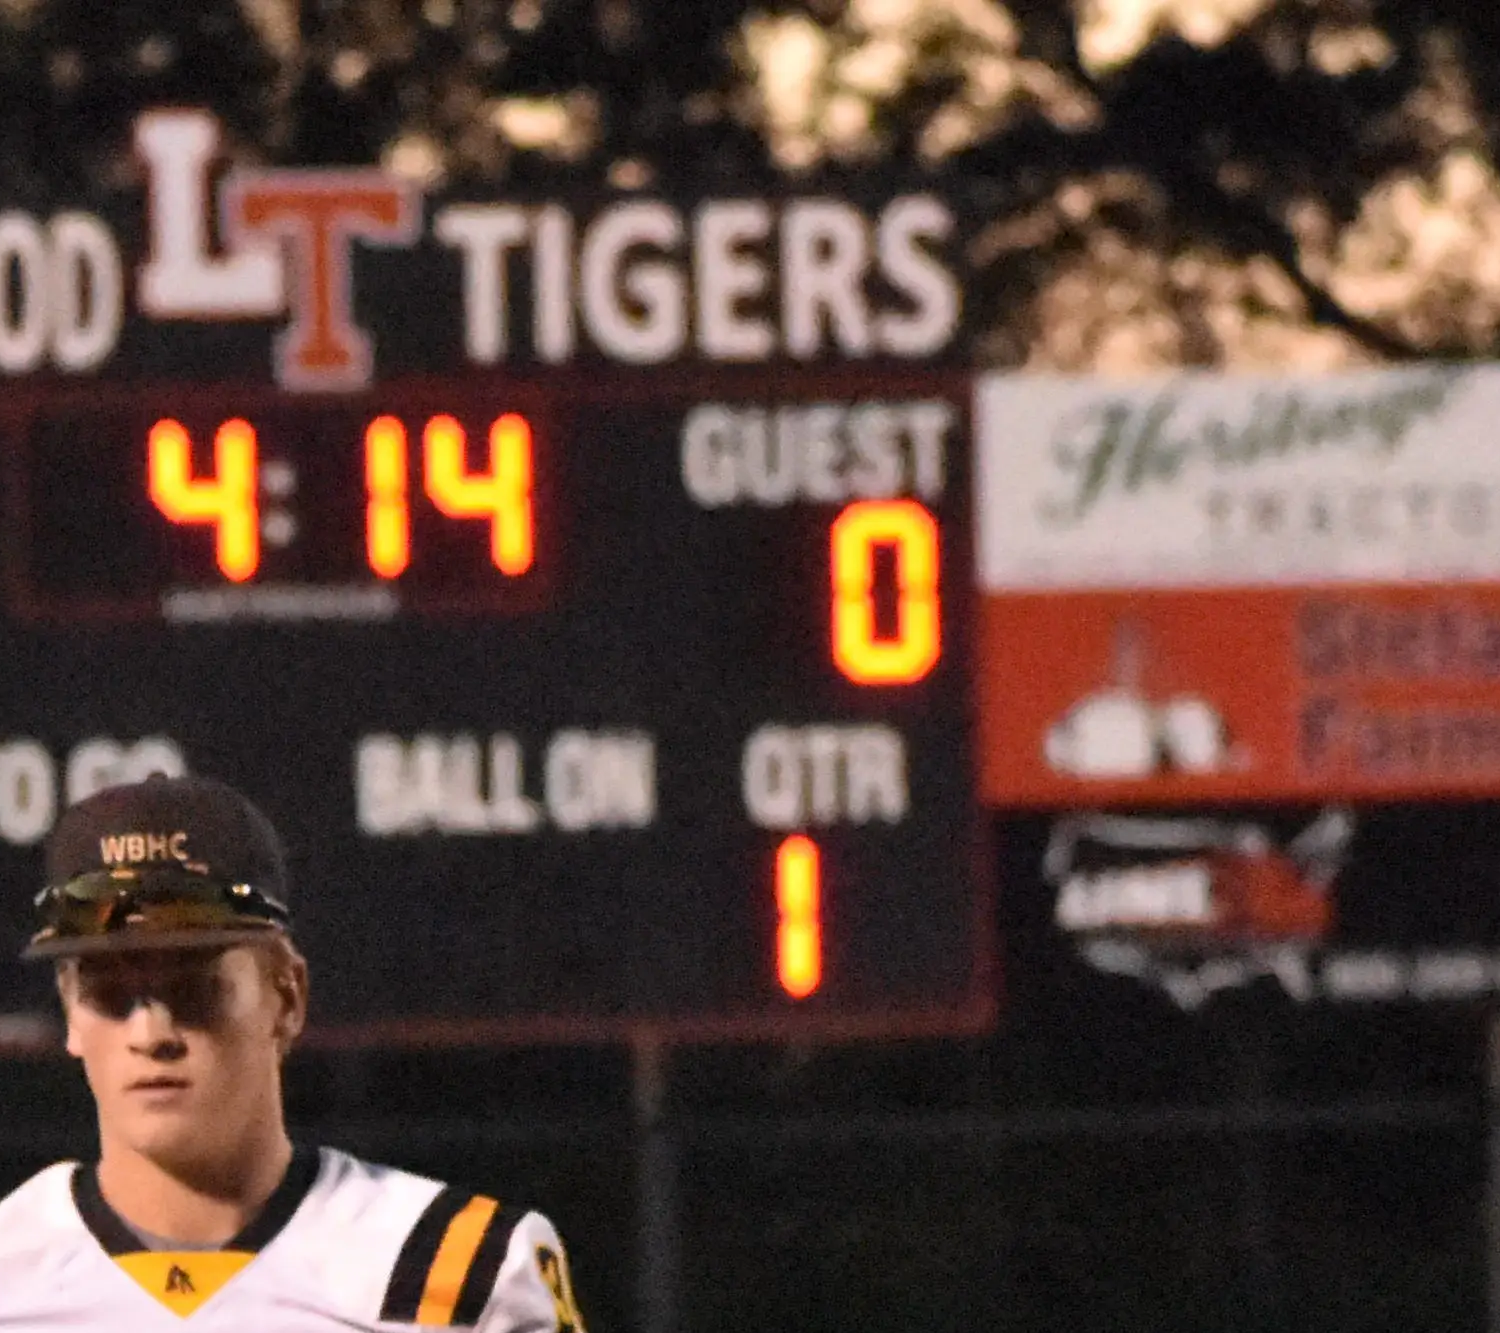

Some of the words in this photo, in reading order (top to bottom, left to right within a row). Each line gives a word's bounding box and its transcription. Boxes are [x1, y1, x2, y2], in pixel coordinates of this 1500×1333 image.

[433, 195, 963, 366] TIGERS
[147, 414, 536, 581] 4:14
[681, 402, 957, 505] GUEST
[830, 498, 942, 685] 0
[355, 731, 540, 837] BALL
[545, 727, 658, 833] ON
[742, 724, 910, 830] QTR
[100, 830, 190, 867] WBHC
[775, 834, 821, 998] 1
